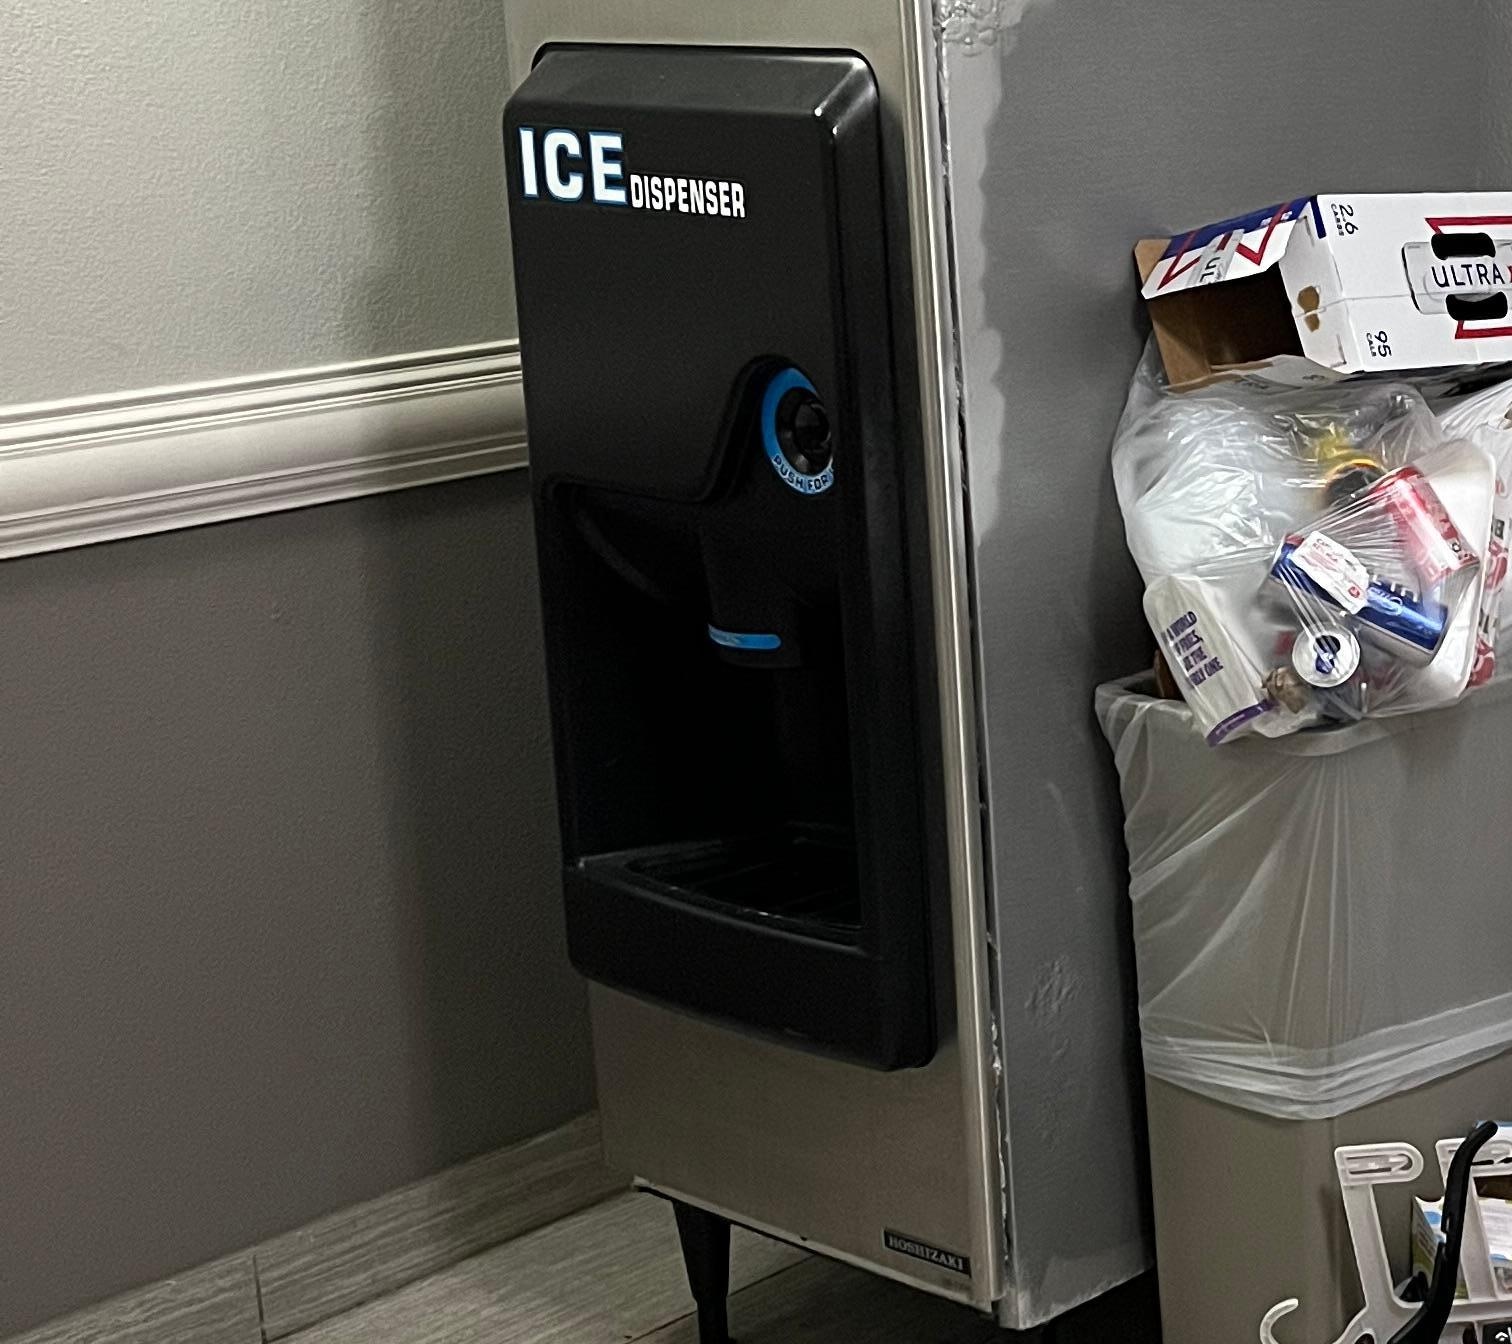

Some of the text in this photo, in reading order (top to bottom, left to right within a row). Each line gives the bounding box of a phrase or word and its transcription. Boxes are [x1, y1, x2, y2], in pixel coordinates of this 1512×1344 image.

[518, 127, 746, 218] ICE DISPENSER
[1431, 263, 1505, 288] ULTRA
[1374, 330, 1392, 357] 95
[773, 454, 805, 488] PUSH
[807, 474, 829, 490] FOR
[888, 1235, 965, 1271] HOSHIZAKI
